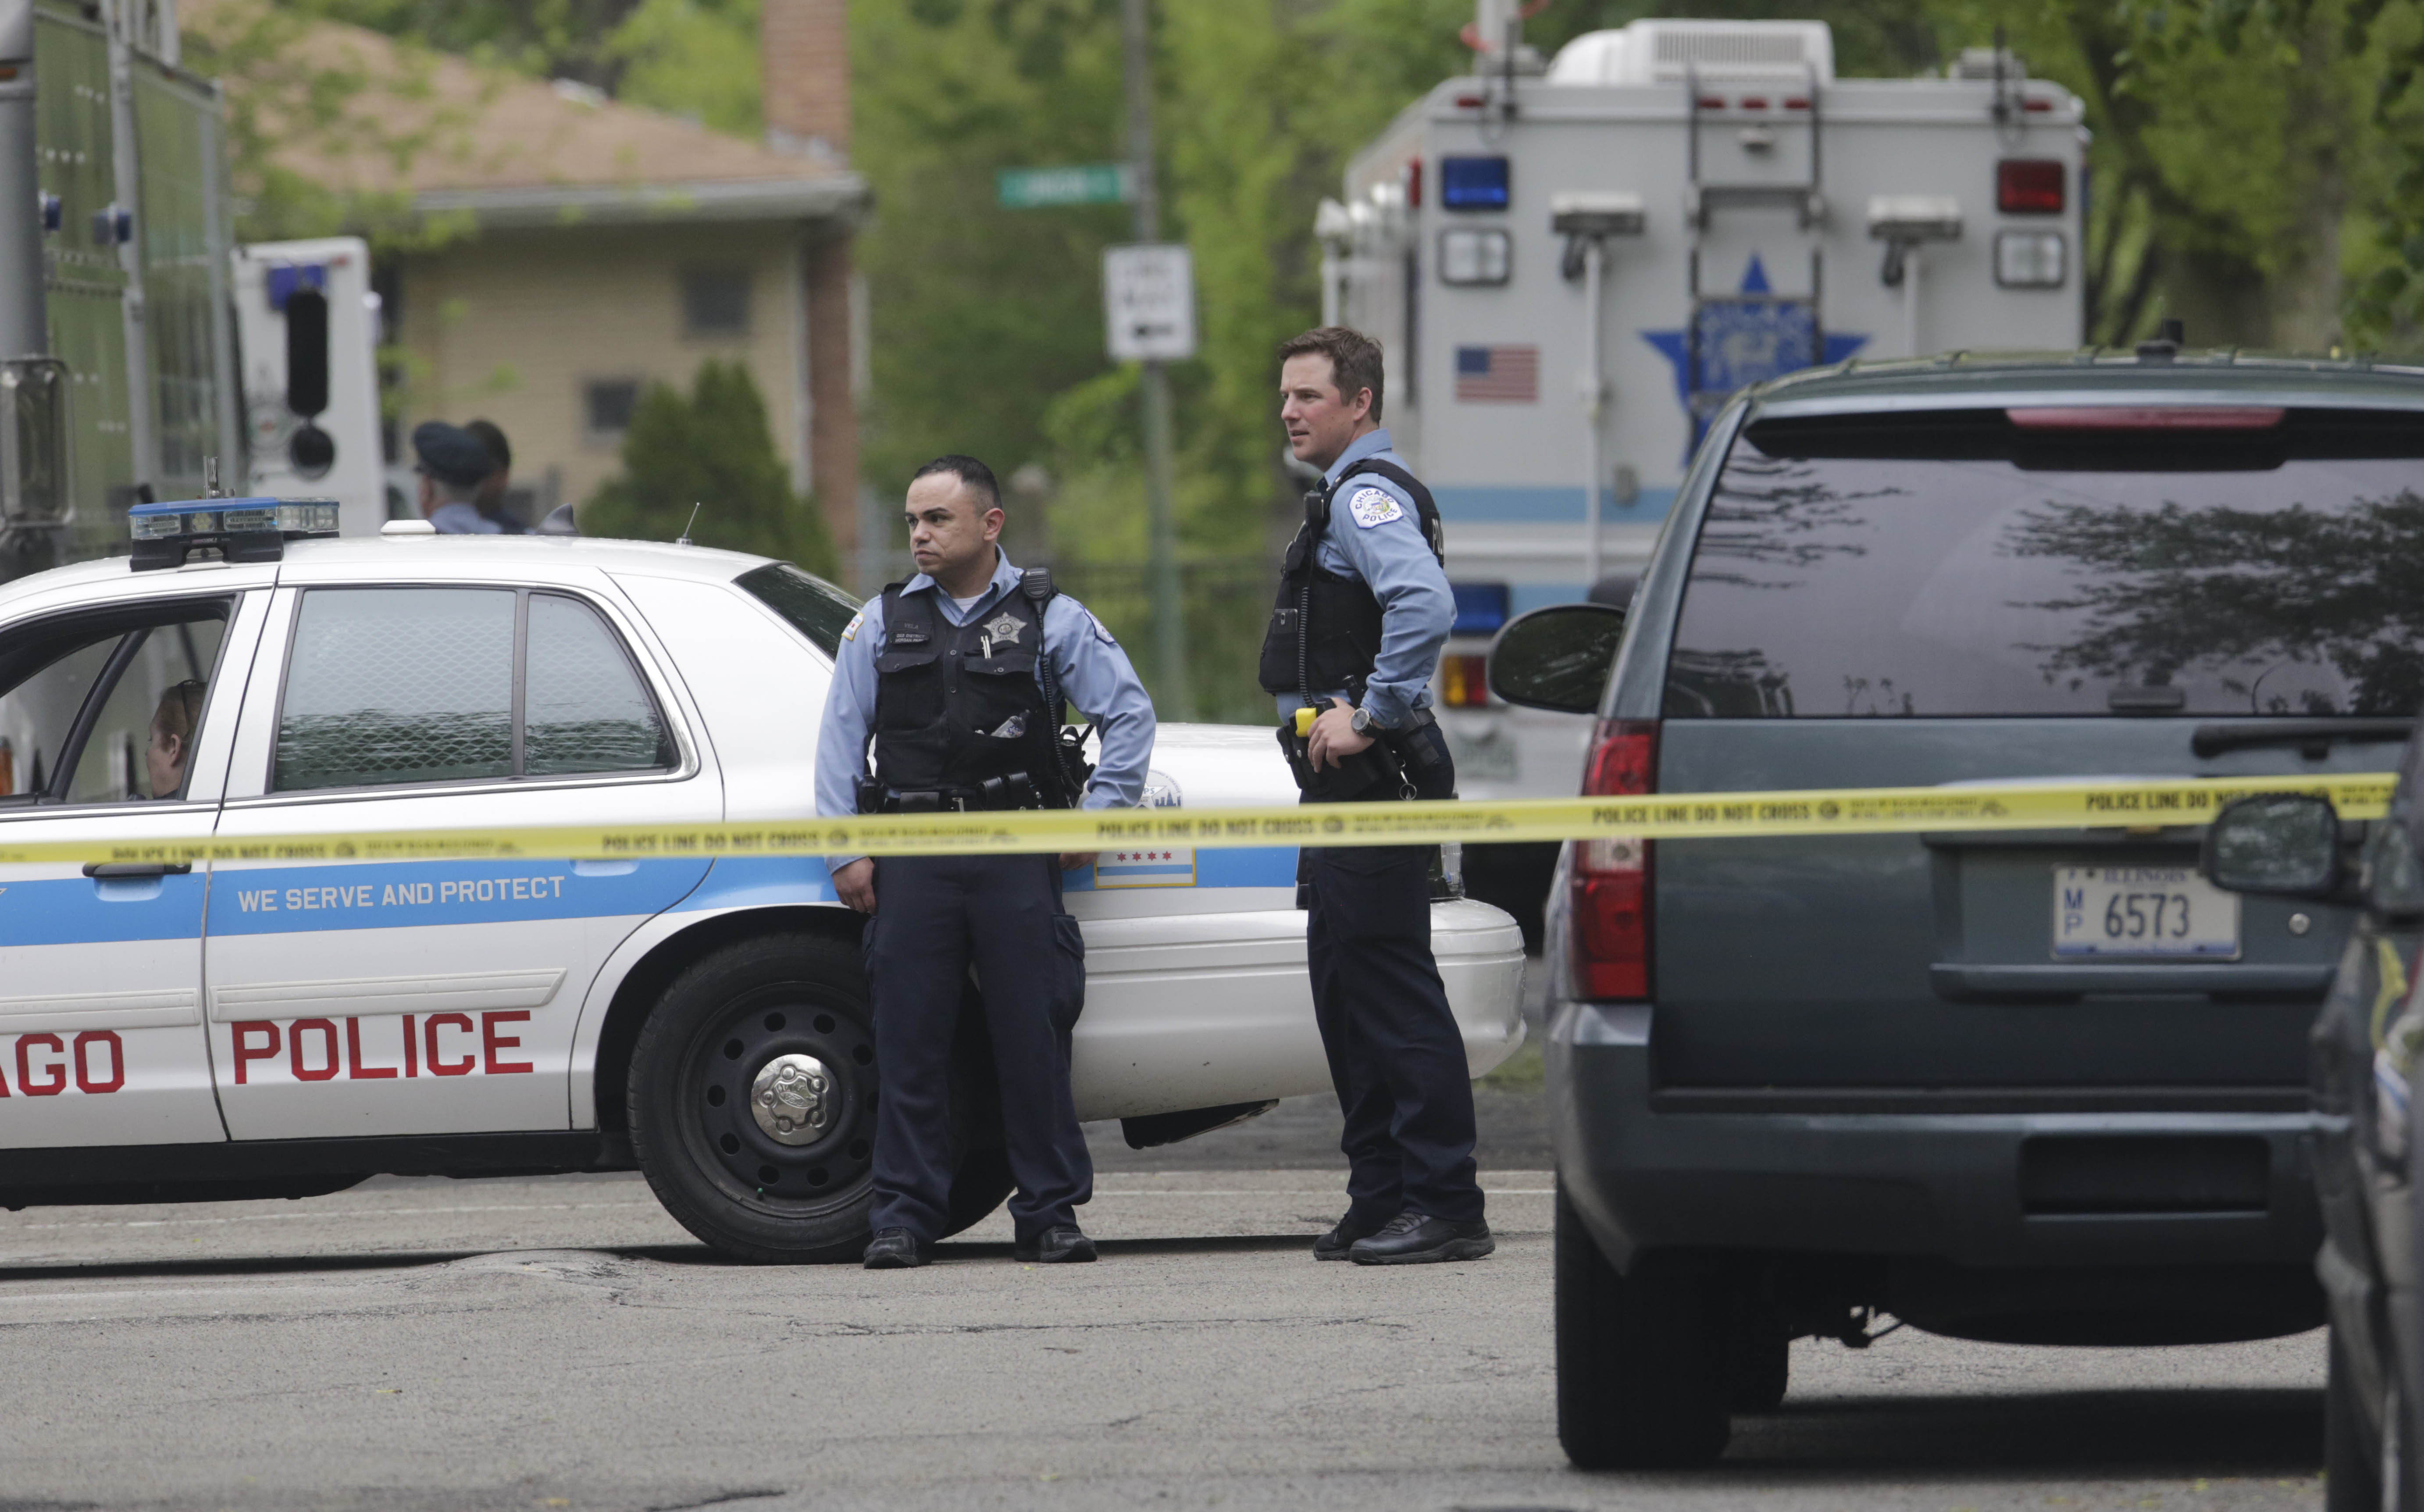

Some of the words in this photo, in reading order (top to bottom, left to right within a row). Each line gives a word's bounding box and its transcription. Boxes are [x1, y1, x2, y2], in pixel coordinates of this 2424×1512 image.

[1355, 490, 1394, 509] CHICAGO
[1362, 508, 1397, 521] POLICE
[2086, 793, 2140, 811] POLICE
[2146, 792, 2180, 810] LINE
[2187, 791, 2209, 808] DO
[1593, 807, 1648, 825] POLICE
[1654, 806, 1688, 824] LINE
[1695, 805, 1718, 822] DO
[1722, 804, 1753, 821] NOT
[1759, 802, 1811, 820] CROSS
[1097, 821, 1151, 838] POLICE
[1158, 820, 1191, 838] LINE
[1199, 819, 1220, 836] DO
[1227, 817, 1259, 836] NOT
[1262, 816, 1313, 835] CROSS
[112, 847, 164, 859] POLICE
[171, 846, 205, 858] LINE
[213, 846, 232, 858] DO
[240, 845, 270, 857] NOT
[275, 845, 324, 857] CROSS
[603, 834, 656, 852] POLICE
[663, 833, 697, 850] LINE
[705, 832, 726, 849] DO
[731, 831, 763, 849] NOT
[768, 830, 819, 848] CROSS
[2103, 869, 2186, 883] ILLINOIS
[238, 889, 277, 912] WE
[285, 885, 374, 910] SERVE
[381, 882, 433, 906] AND
[440, 876, 565, 903] PROTECT
[2105, 893, 2189, 938] 6573
[231, 1010, 534, 1084] POLICE
[0, 1029, 125, 1097] GO
